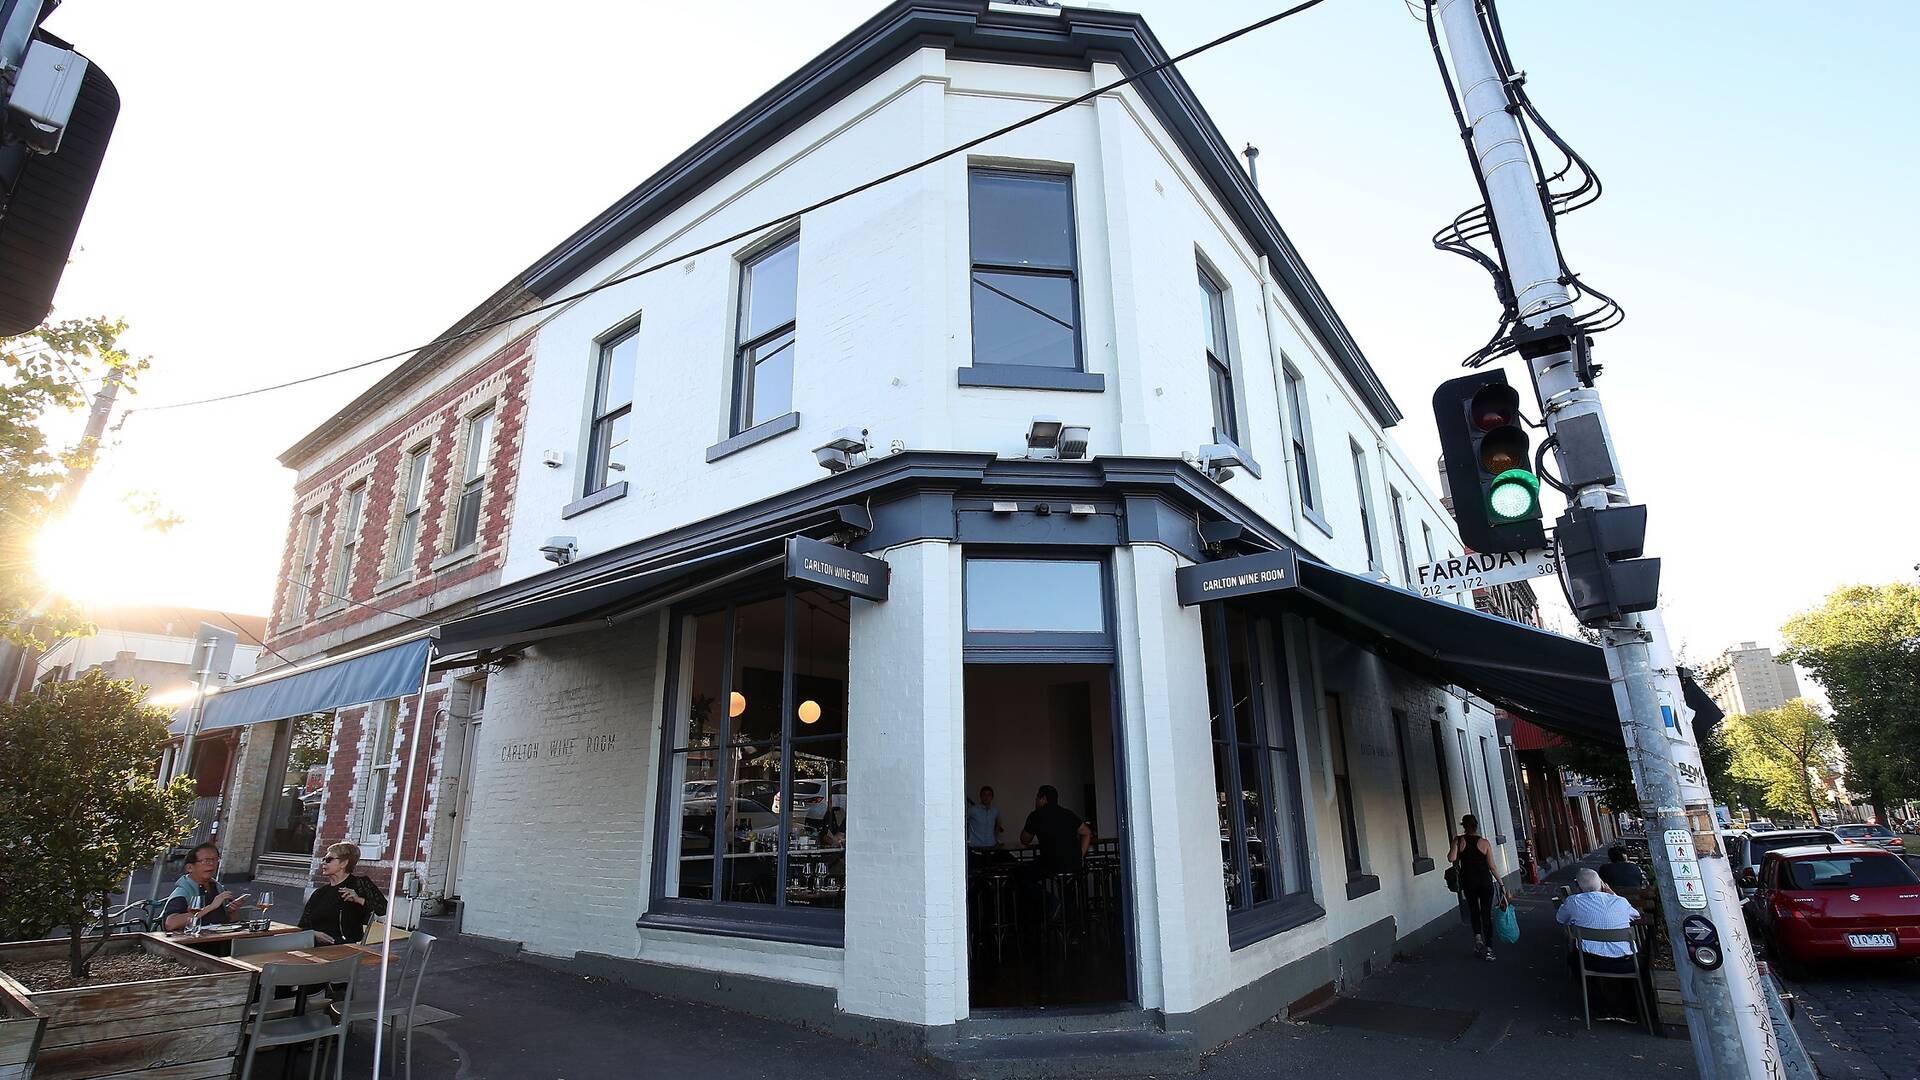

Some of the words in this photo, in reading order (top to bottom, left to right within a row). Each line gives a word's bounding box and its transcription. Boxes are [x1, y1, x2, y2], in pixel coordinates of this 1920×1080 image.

[804, 558, 833, 576] CARLTON
[834, 566, 850, 580] WINE
[851, 571, 869, 585] ROOM
[1203, 576, 1237, 592] CARLTON
[1238, 572, 1259, 586] WINE
[1260, 568, 1285, 583] ROOM
[1418, 549, 1527, 585] FARADAY
[1422, 584, 1441, 597] 212
[1463, 576, 1484, 589] 172
[501, 743, 539, 761] CARLTON
[550, 739, 575, 757] WINE
[586, 734, 616, 753] ROOM
